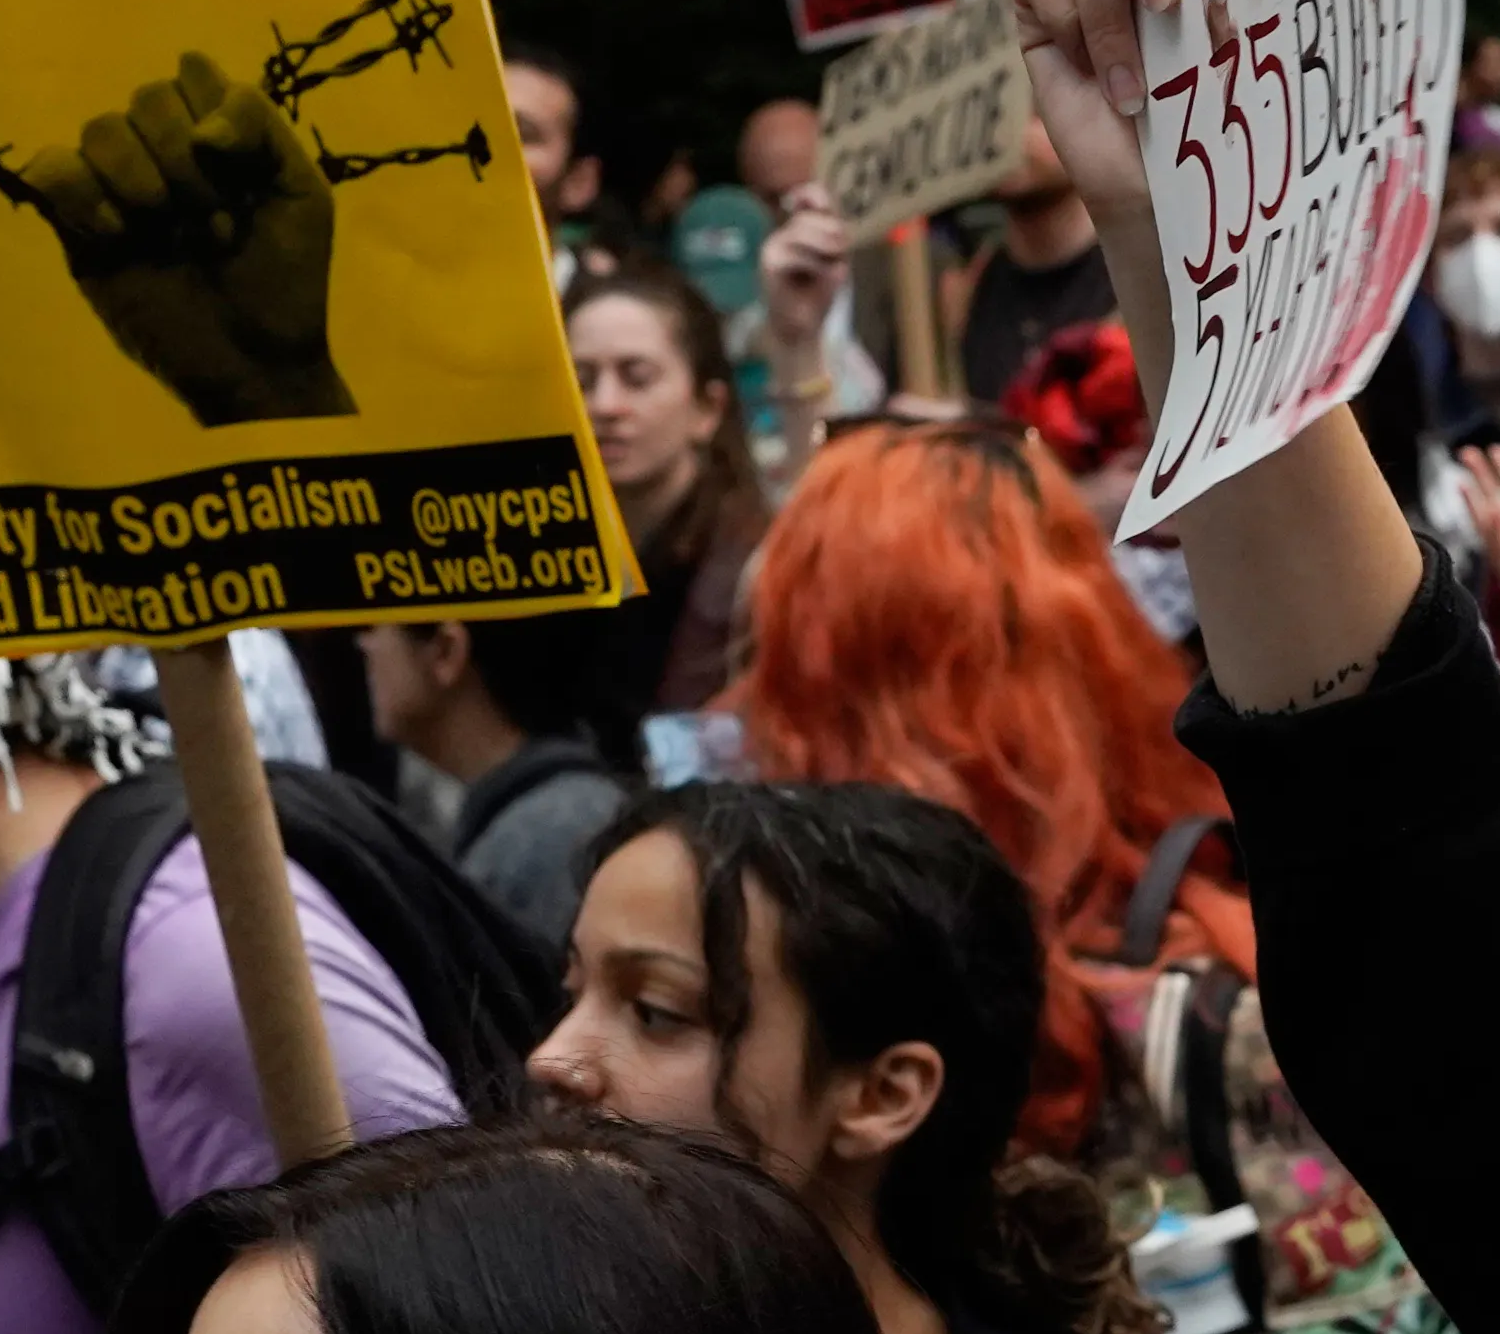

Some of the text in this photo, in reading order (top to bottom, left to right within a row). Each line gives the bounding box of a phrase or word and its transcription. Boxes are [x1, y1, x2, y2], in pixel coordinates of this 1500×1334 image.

[1151, 13, 1292, 285] 335
[45, 495, 104, 553] for
[116, 468, 381, 555] Socialism
[412, 470, 589, 548] @nycpsl
[28, 561, 287, 634] Liberation
[355, 542, 603, 600] PSLweb.org
